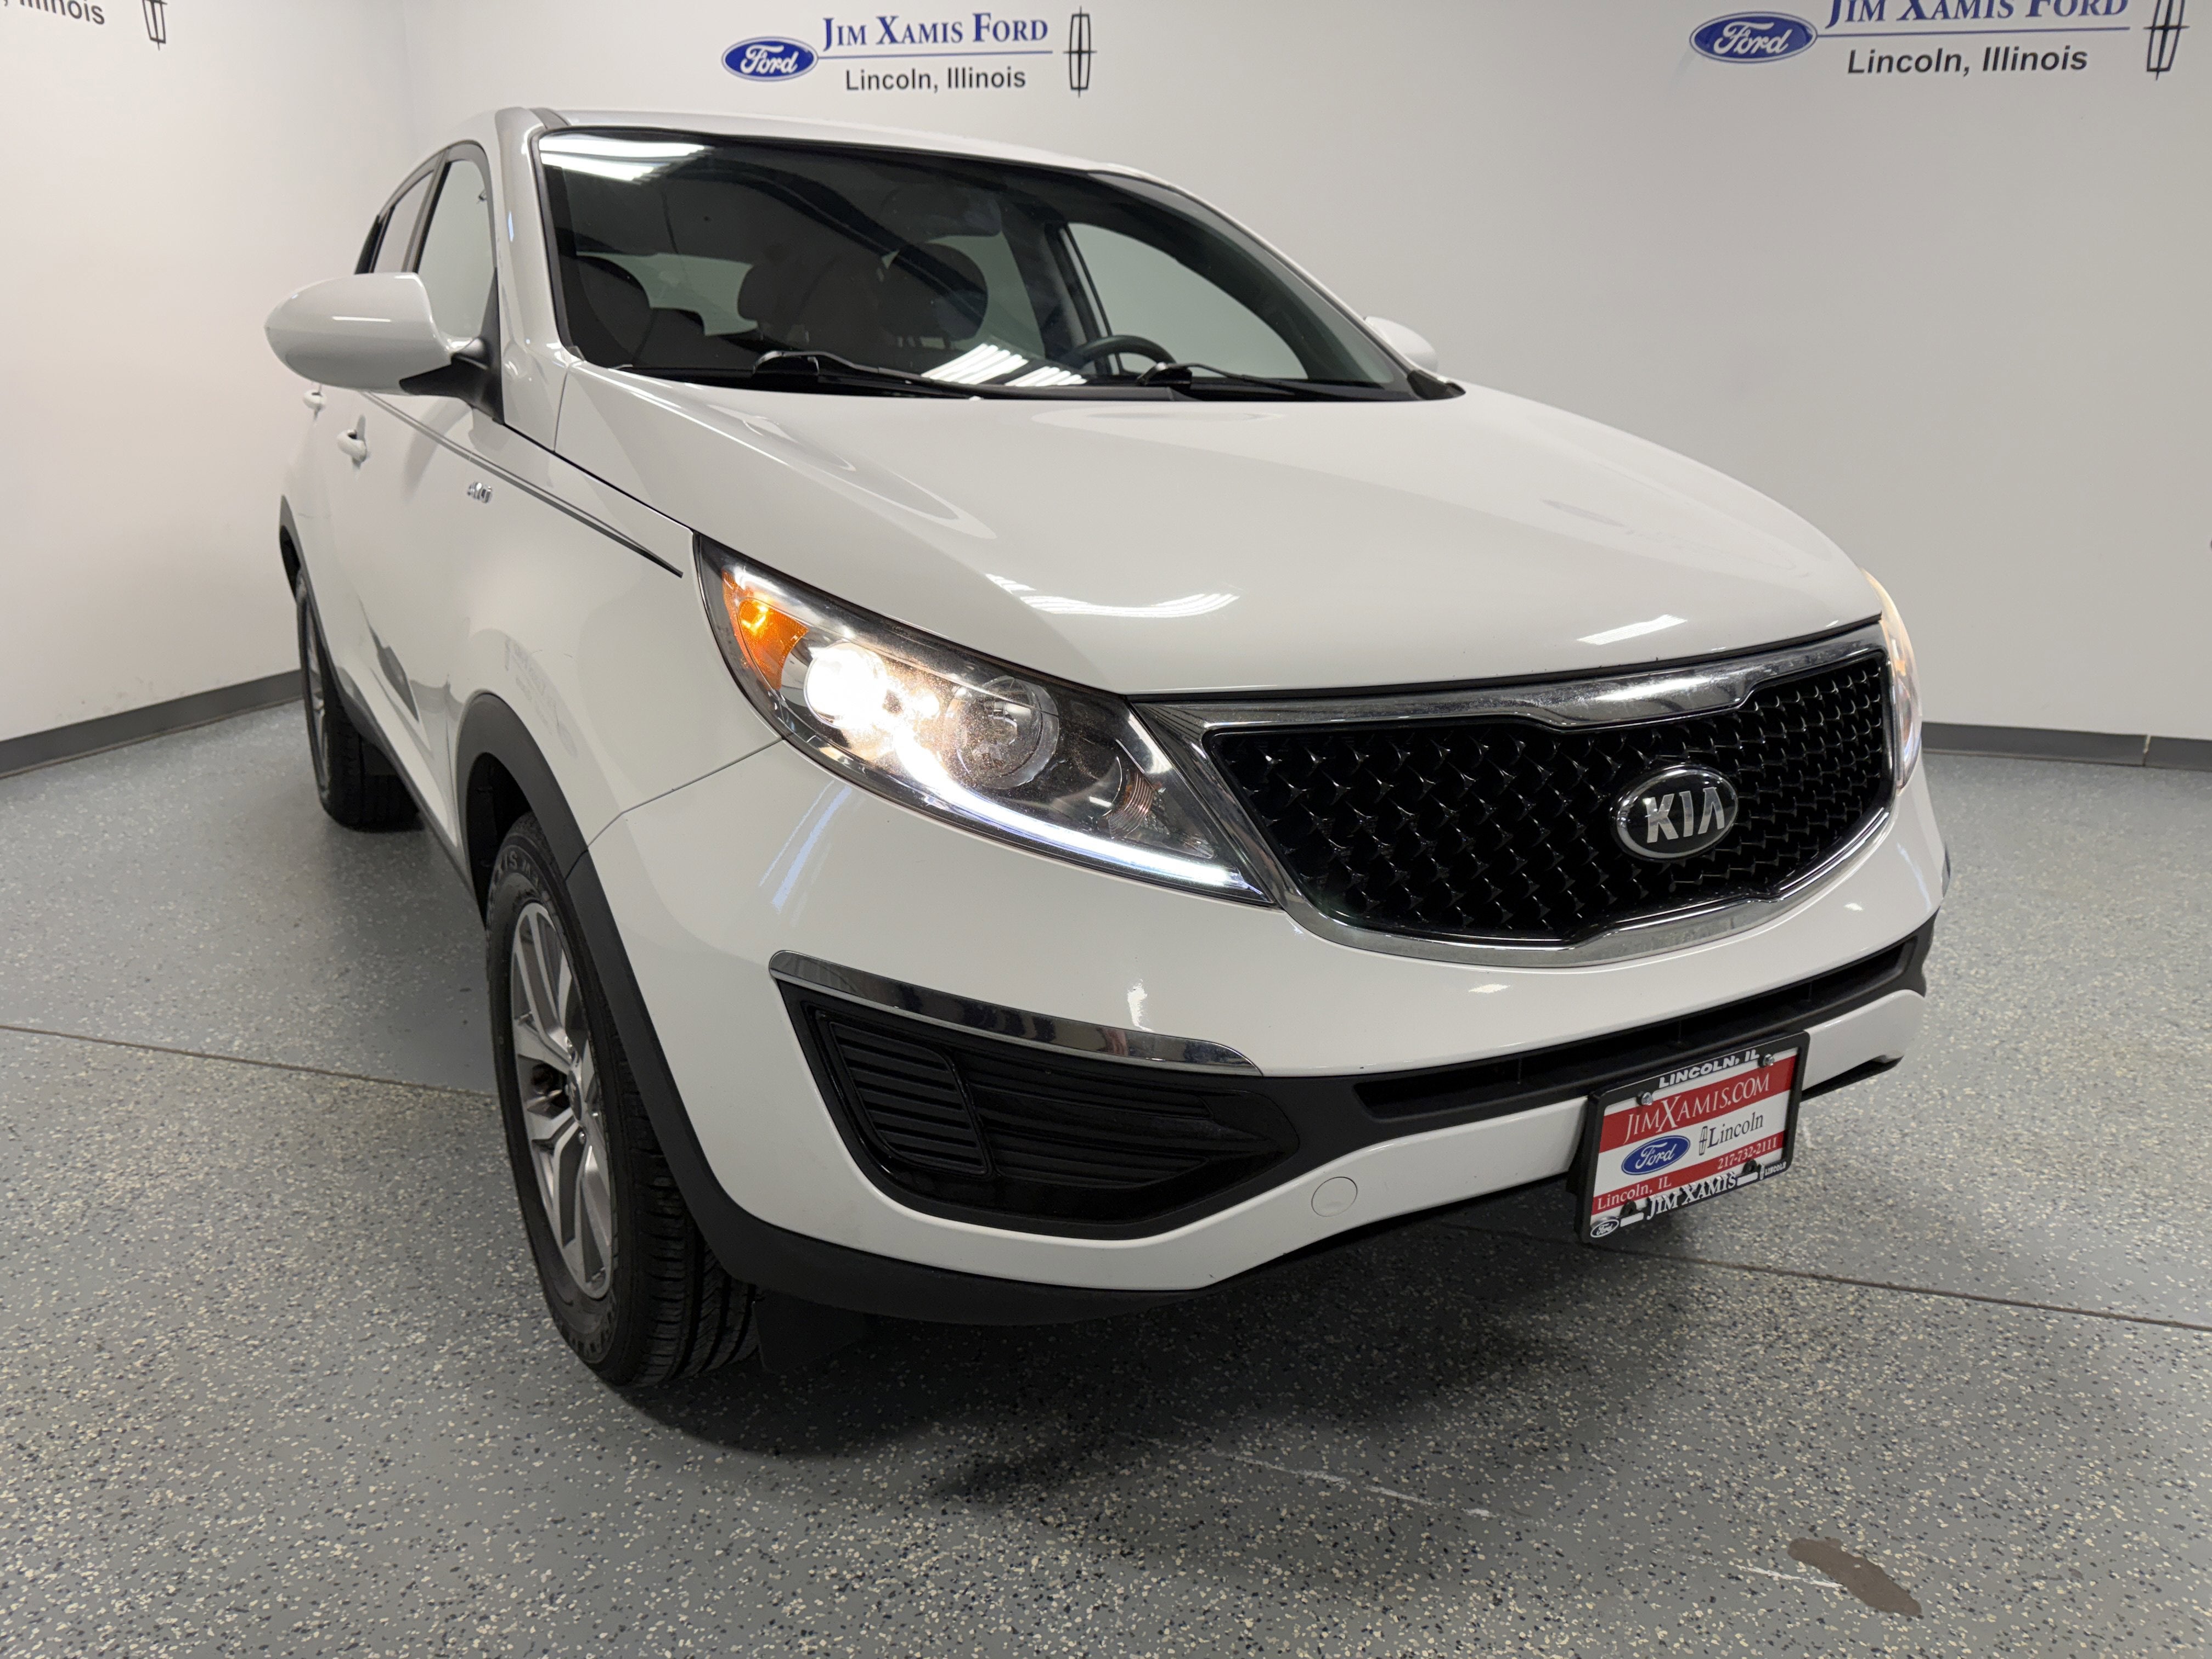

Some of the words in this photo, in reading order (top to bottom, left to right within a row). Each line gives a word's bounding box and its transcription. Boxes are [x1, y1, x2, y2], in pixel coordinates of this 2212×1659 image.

[20, 0, 105, 25] nois
[1713, 21, 1793, 54] Ford
[741, 44, 799, 74] Ford
[1848, 48, 1970, 76] Lincoln,
[1983, 45, 2088, 72] Illinois
[847, 68, 939, 93] Lincoln,
[947, 66, 1026, 89] Illinois
[1645, 787, 1725, 843] KIA
[1658, 1056, 1740, 1088] LINCOLN,
[1745, 1049, 1760, 1062] IL
[1623, 1073, 1769, 1144] JIMXAMIS.COM
[1707, 1111, 1763, 1148] Lincoln
[1635, 1142, 1677, 1170] Ford
[1717, 1137, 1778, 1170] 217-732-2111
[1598, 1184, 1652, 1210] Lincoln,
[1658, 1176, 1672, 1189] IL
[1646, 1192, 1678, 1220] JIM
[1681, 1173, 1736, 1205] XAMIS
